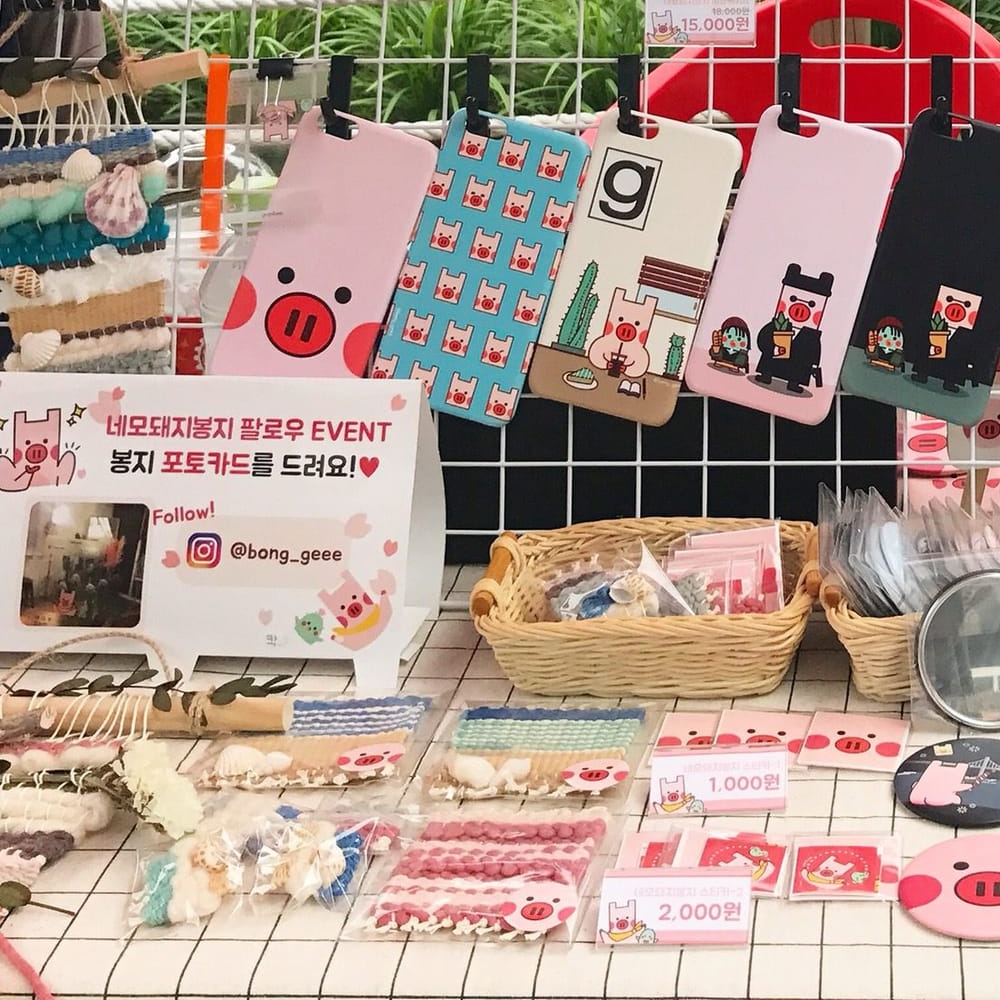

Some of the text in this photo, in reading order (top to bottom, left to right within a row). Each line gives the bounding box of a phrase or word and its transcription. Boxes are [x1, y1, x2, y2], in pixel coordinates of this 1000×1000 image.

[681, 17, 750, 32] 15,000원
[598, 160, 655, 220] g
[106, 414, 392, 443] 네모돼지봉지 팔로우 EVENT
[110, 449, 356, 479] 봉지 포토카드를 드려요!
[152, 501, 215, 526] Follow!
[230, 541, 342, 565] @bong_geee
[709, 774, 780, 792] 1,000원
[658, 902, 742, 922] 2,000원
